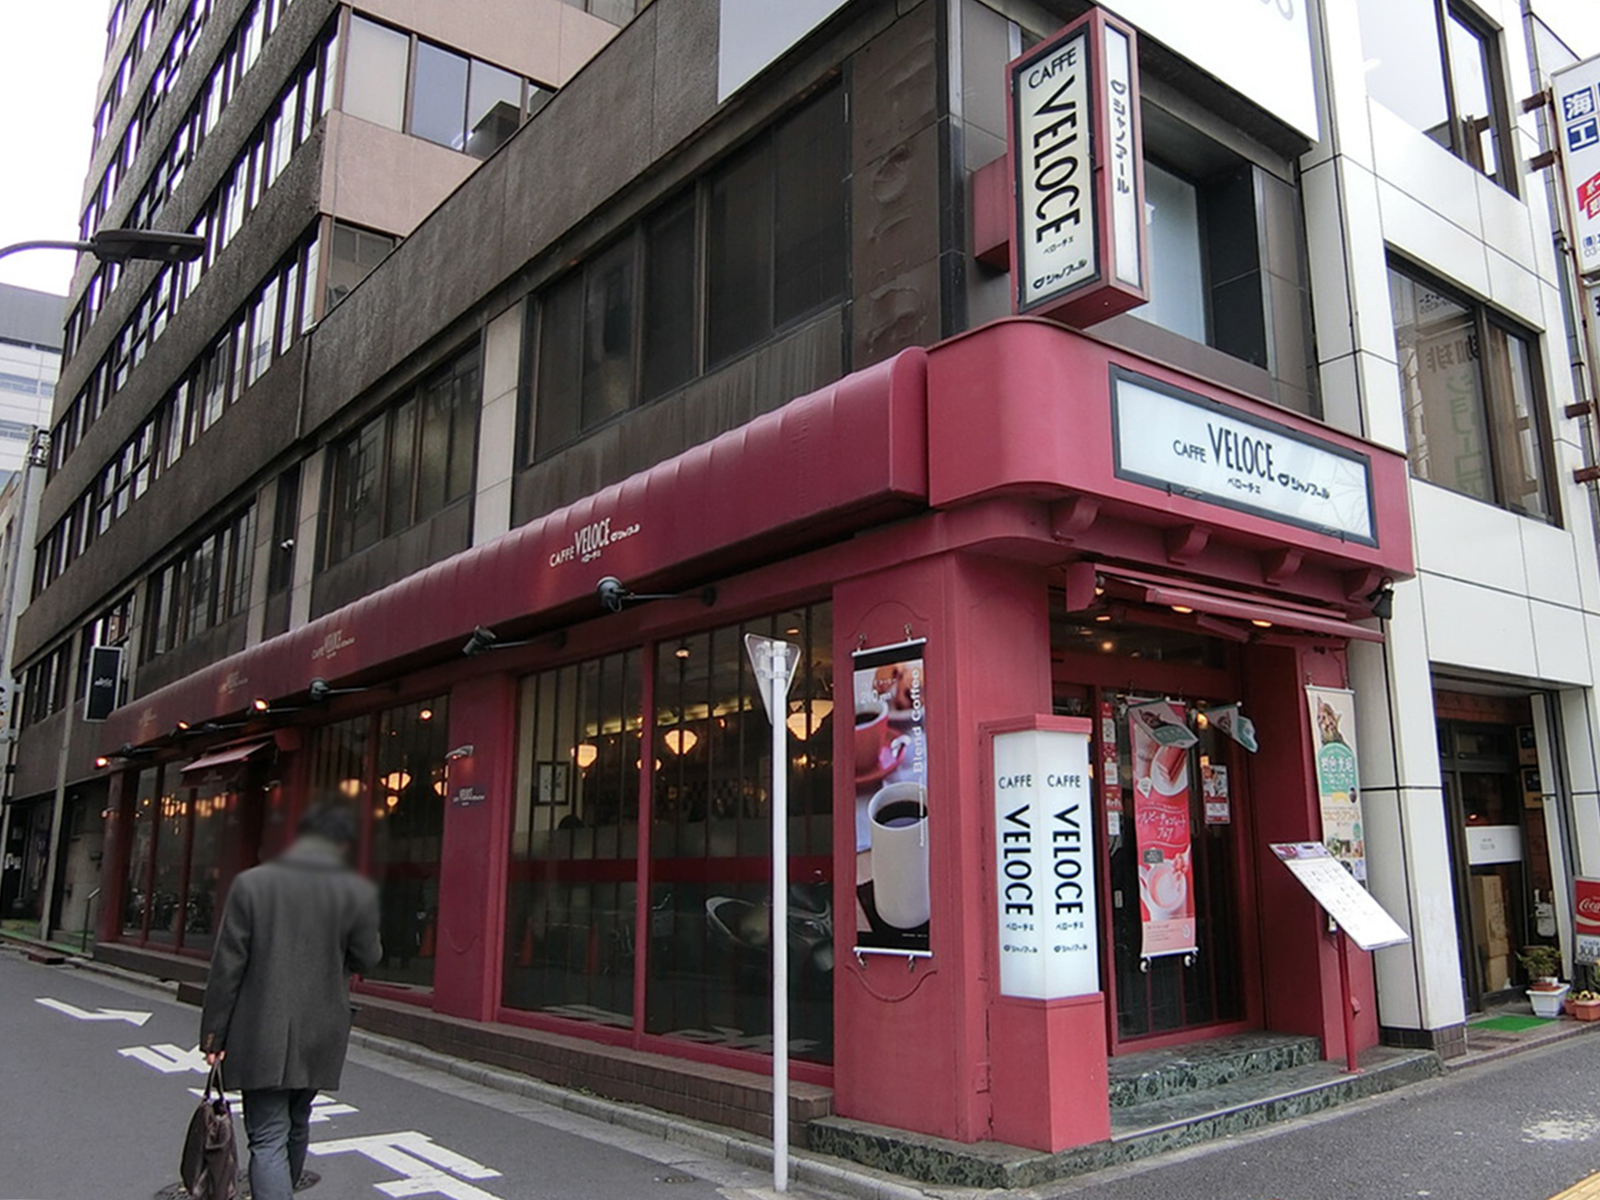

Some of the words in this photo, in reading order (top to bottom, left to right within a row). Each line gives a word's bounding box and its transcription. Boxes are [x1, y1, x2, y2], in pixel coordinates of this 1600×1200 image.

[1028, 46, 1077, 89] CAFFE
[1033, 74, 1081, 244] VELOCE
[1173, 440, 1207, 463] CAFFE
[1207, 422, 1275, 482] VELOCE
[574, 517, 611, 555] VELOCE
[910, 668, 921, 722] Coffee
[913, 726, 923, 773] Blend
[998, 774, 1033, 790] CAFFE
[1047, 774, 1082, 789] CAFFE
[1003, 804, 1034, 916] VELOCE
[1053, 803, 1084, 915] VELOCE
